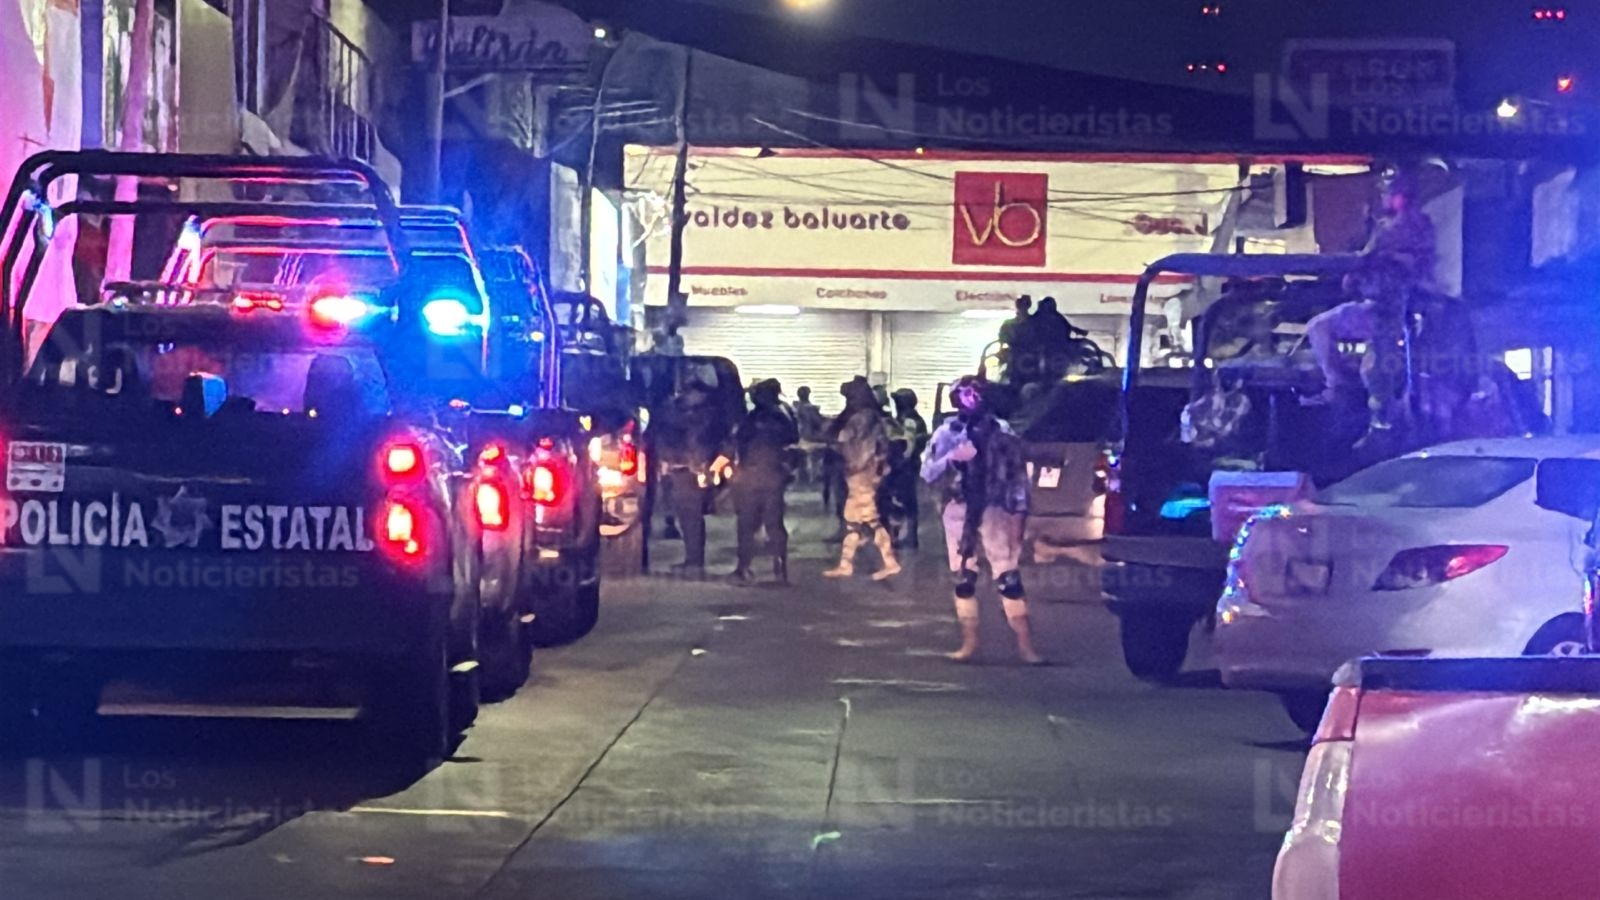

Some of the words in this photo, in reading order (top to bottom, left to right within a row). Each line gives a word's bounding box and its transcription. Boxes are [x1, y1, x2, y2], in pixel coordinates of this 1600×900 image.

[783, 207, 909, 230] baluarte
[0, 490, 148, 547] POLICÍA
[221, 504, 374, 551] ESTATAL
